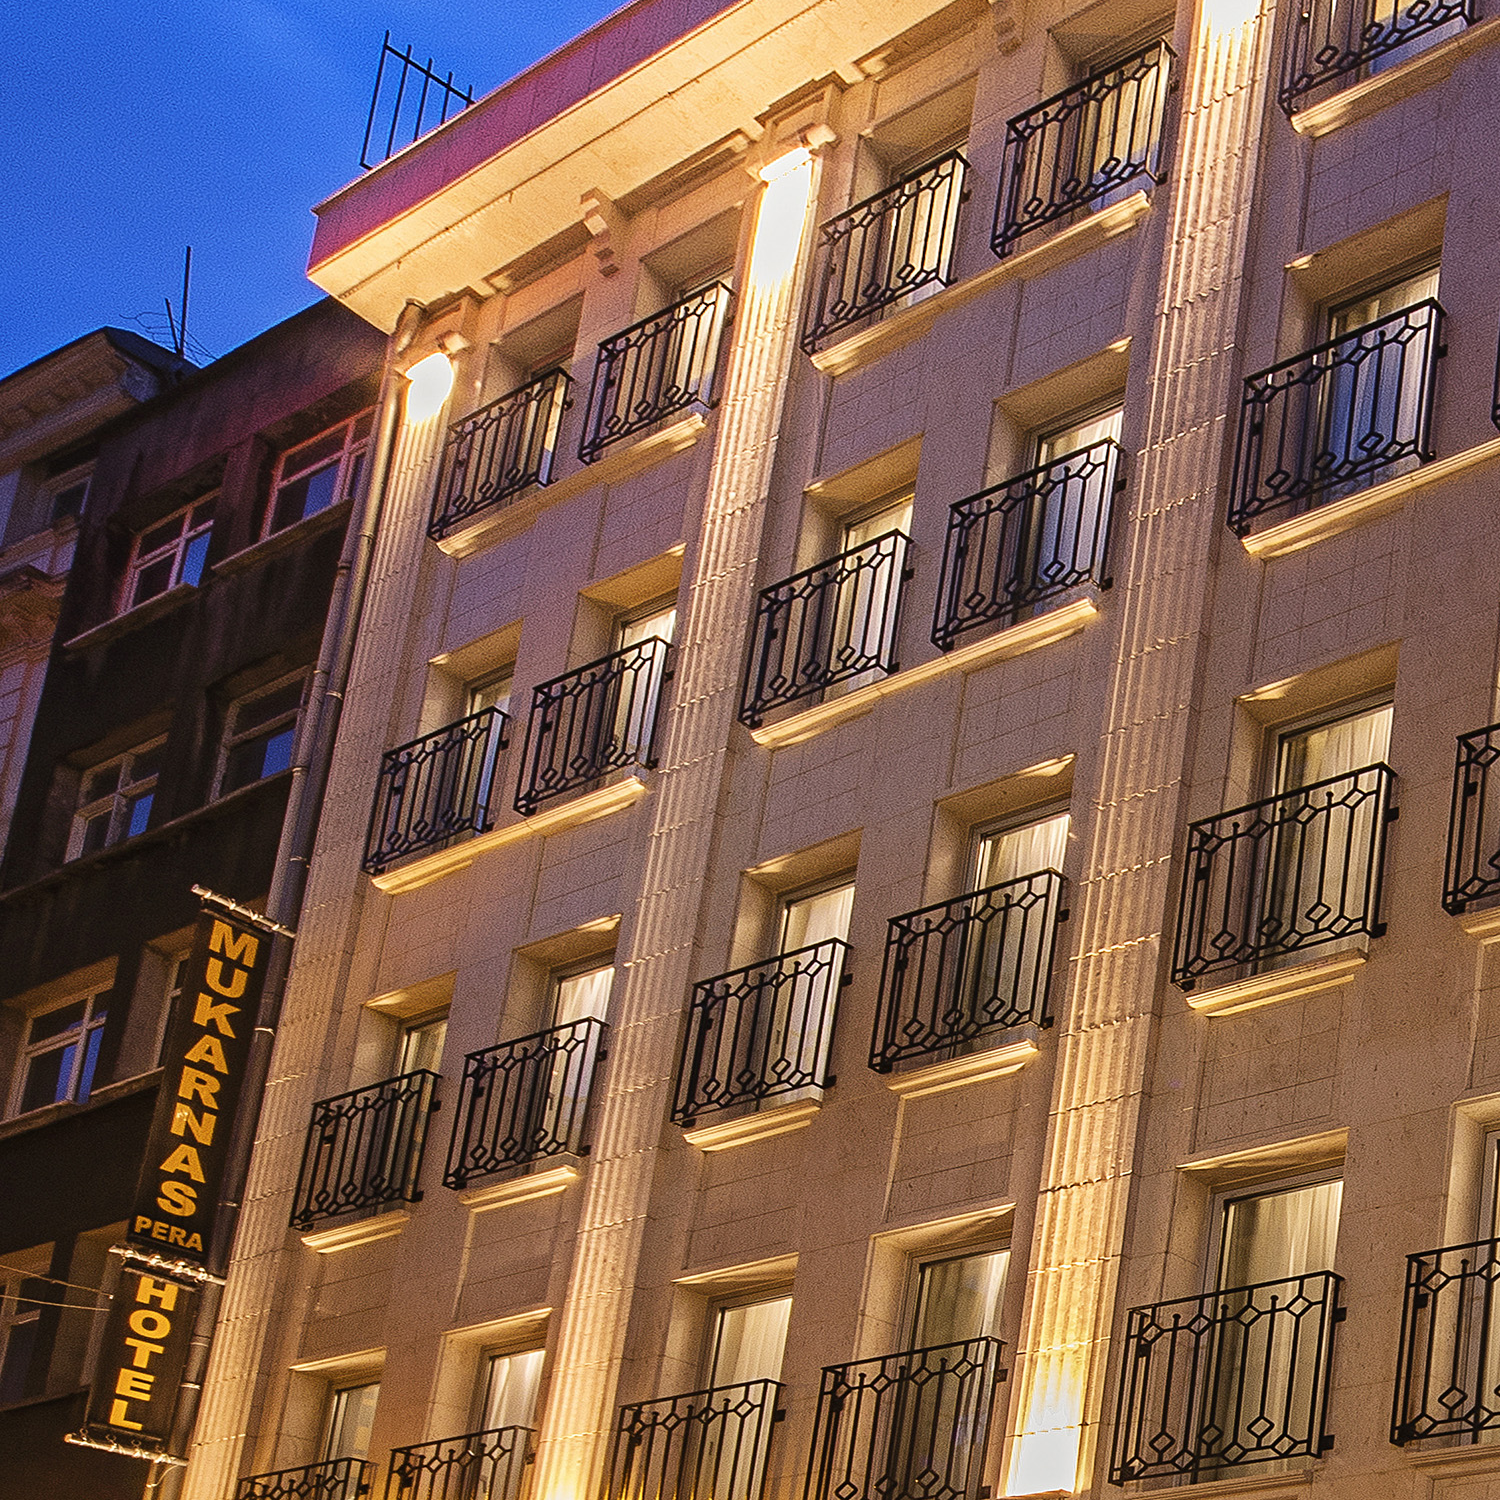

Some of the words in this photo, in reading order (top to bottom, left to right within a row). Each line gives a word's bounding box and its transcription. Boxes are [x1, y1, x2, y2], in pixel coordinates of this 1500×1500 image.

[157, 919, 260, 1219] MUKARNAS
[133, 1214, 204, 1253] PERA
[108, 1273, 179, 1432] HOTEL
